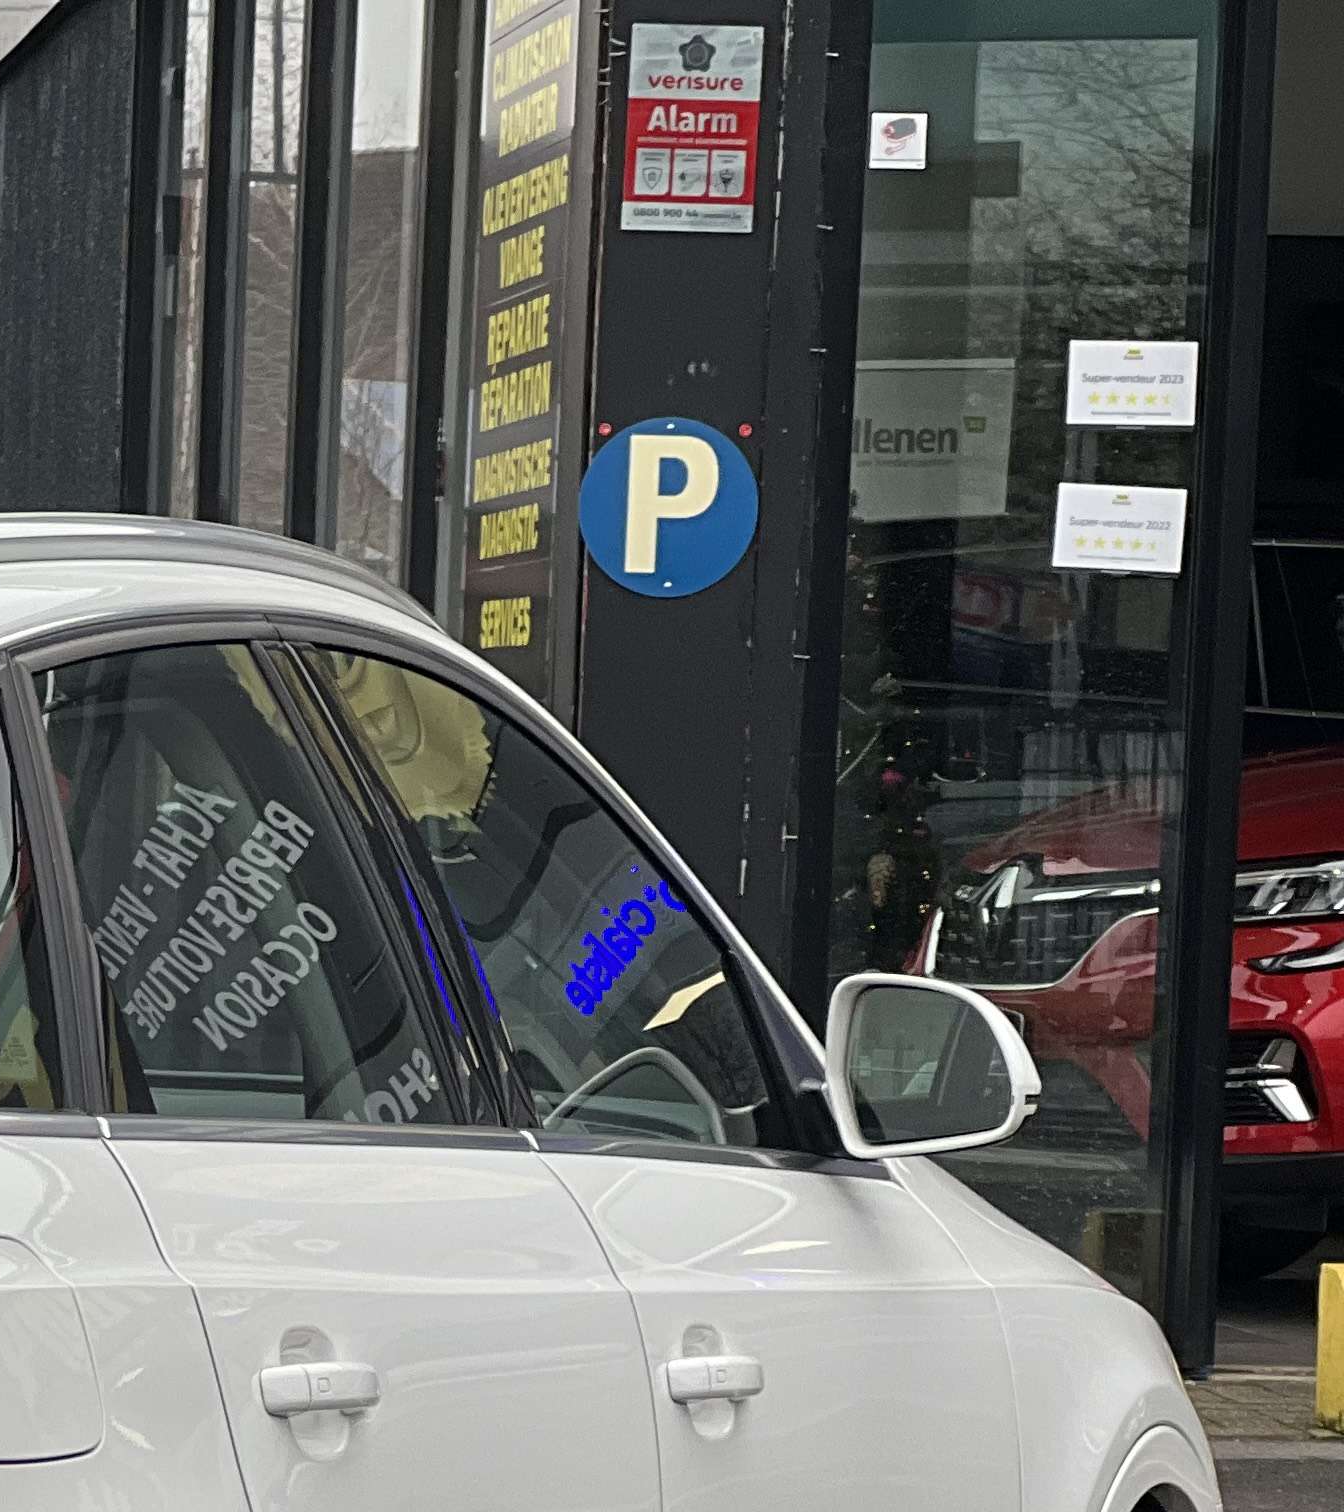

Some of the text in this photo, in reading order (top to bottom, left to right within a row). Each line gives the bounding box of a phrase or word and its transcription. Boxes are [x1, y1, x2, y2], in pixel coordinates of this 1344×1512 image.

[648, 74, 744, 92] verisure
[647, 104, 737, 134] Alarm
[633, 207, 660, 217] 0800
[487, 293, 550, 366] REPARATIE
[1159, 374, 1184, 385] 2023
[623, 434, 719, 574] P
[480, 596, 531, 649] SERVICES
